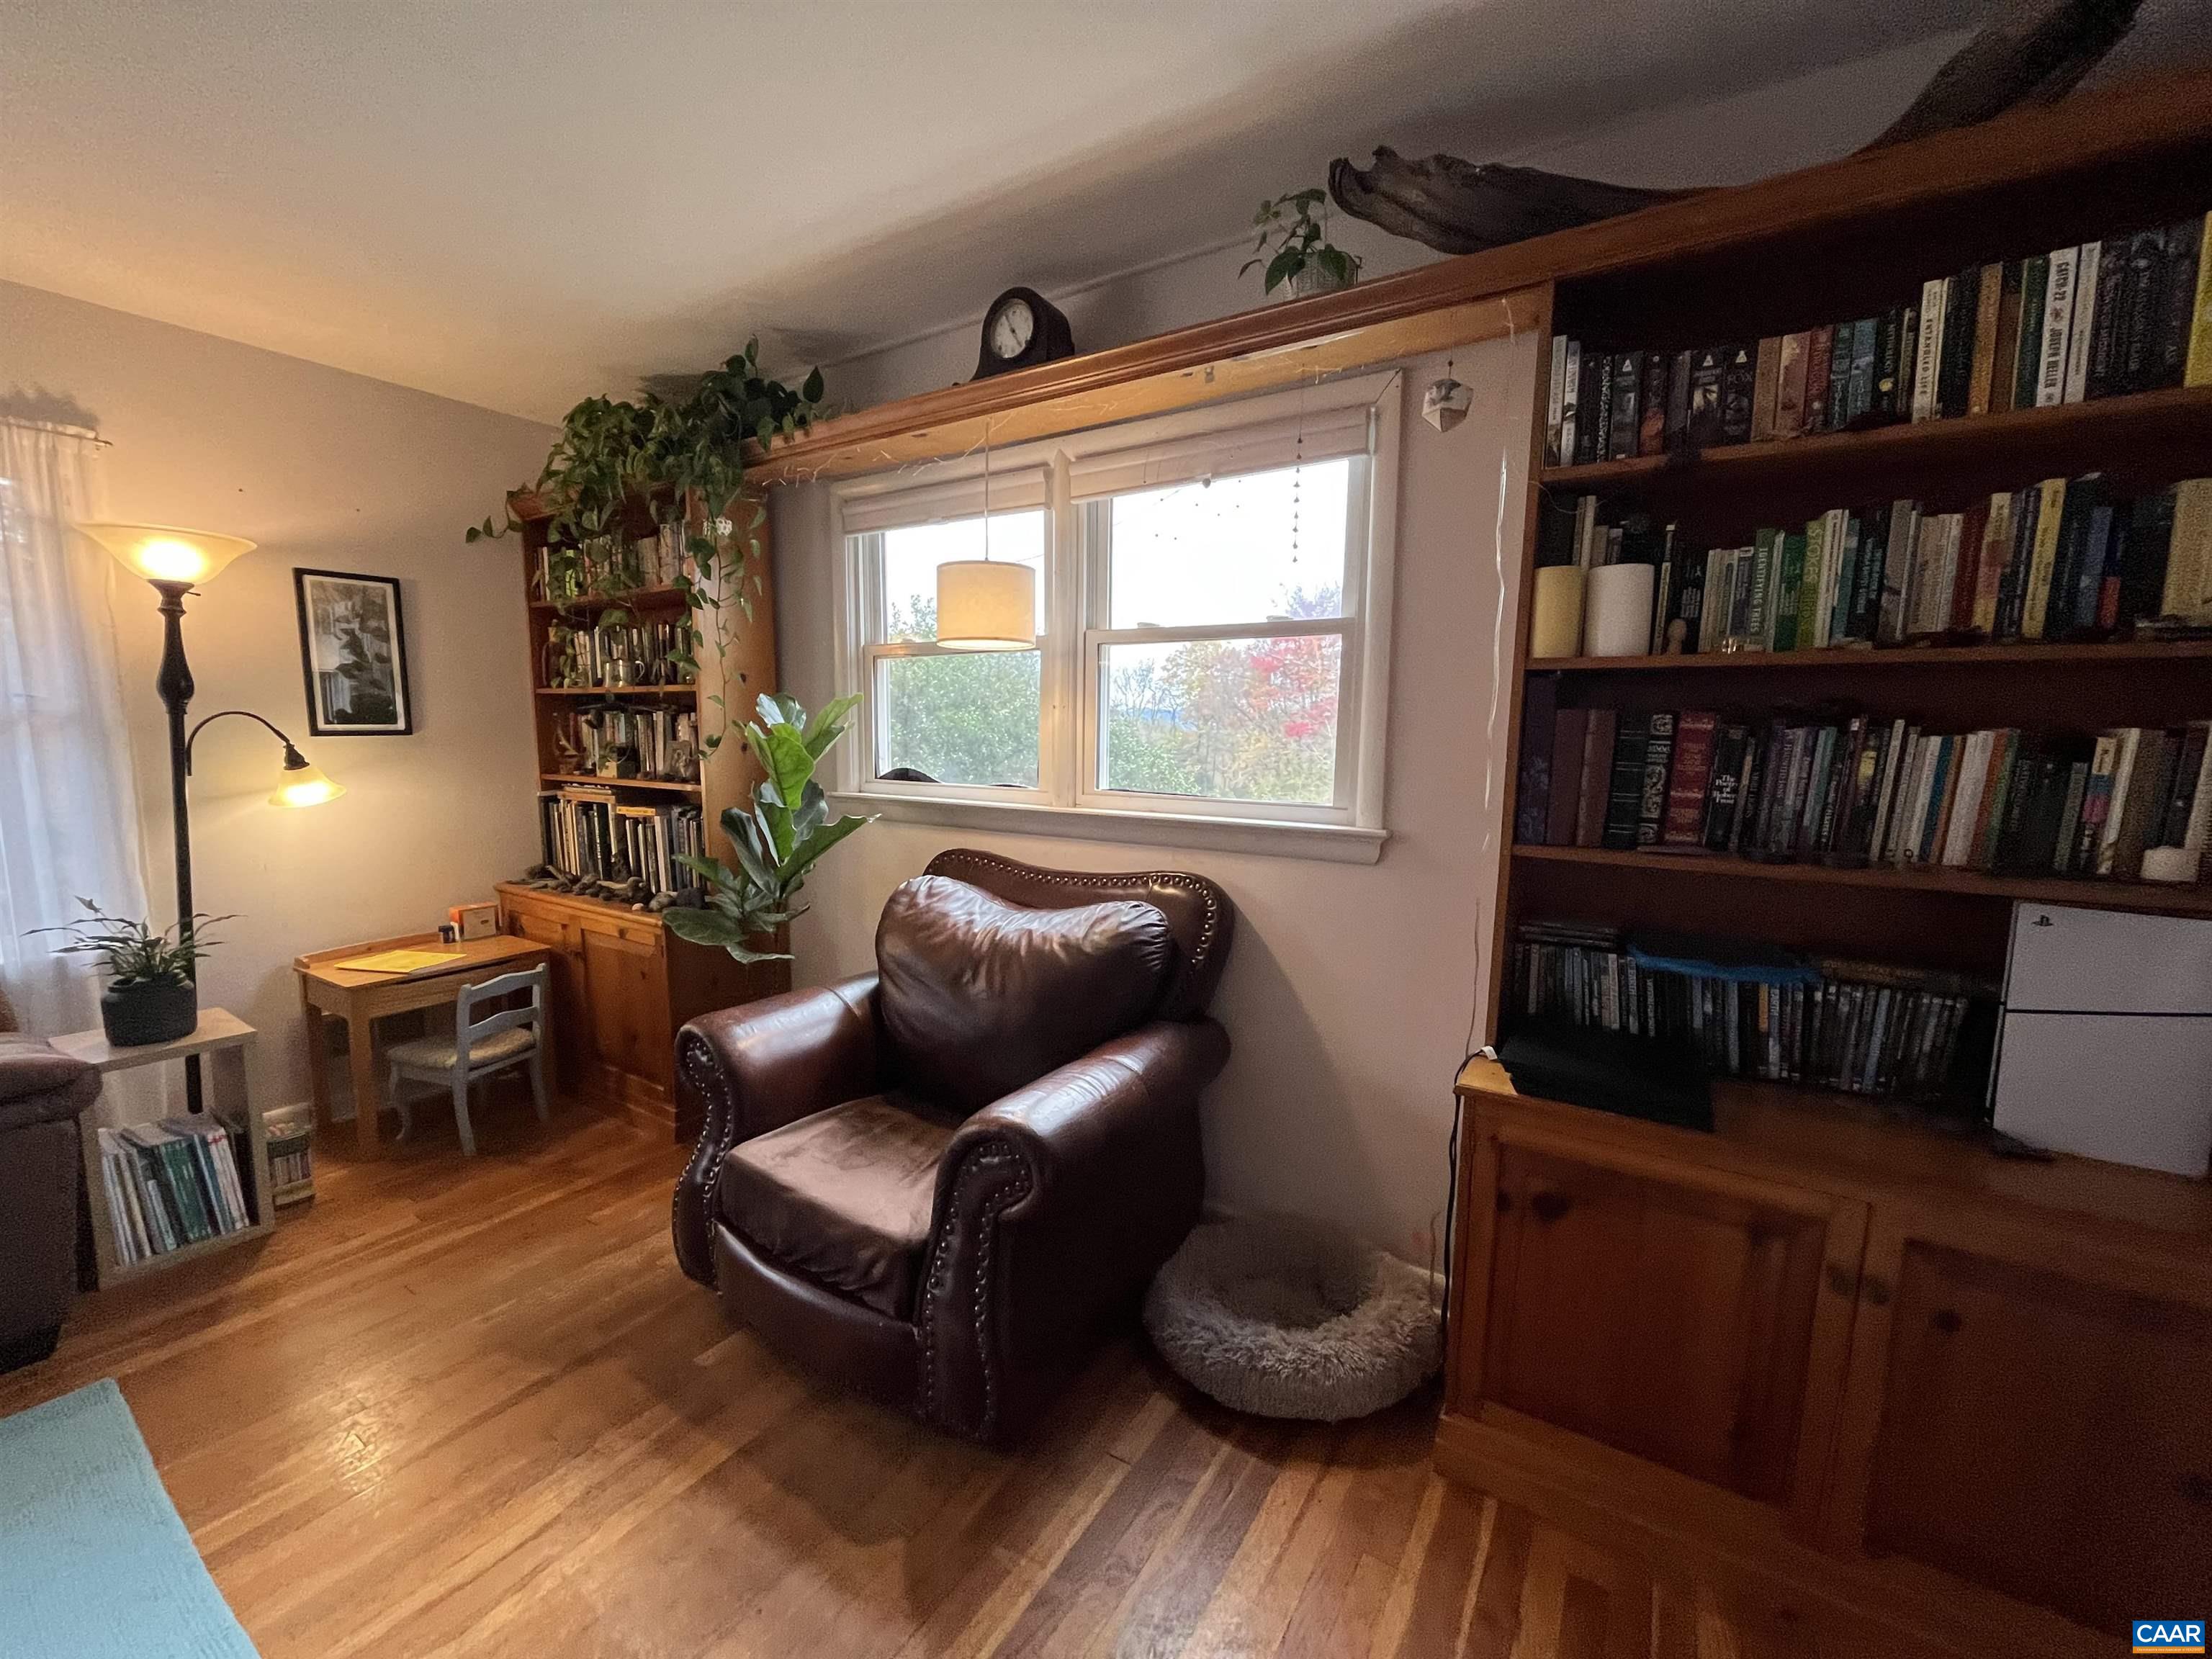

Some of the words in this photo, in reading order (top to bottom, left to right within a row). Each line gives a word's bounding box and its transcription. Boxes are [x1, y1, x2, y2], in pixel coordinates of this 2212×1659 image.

[2054, 261, 2069, 302] CATCH-22
[2049, 328, 2063, 358] JOSEPH
[1753, 547, 1768, 605] IDENTIFYING
[1805, 528, 1824, 583] STOKES
[1750, 606, 1760, 633] TREES
